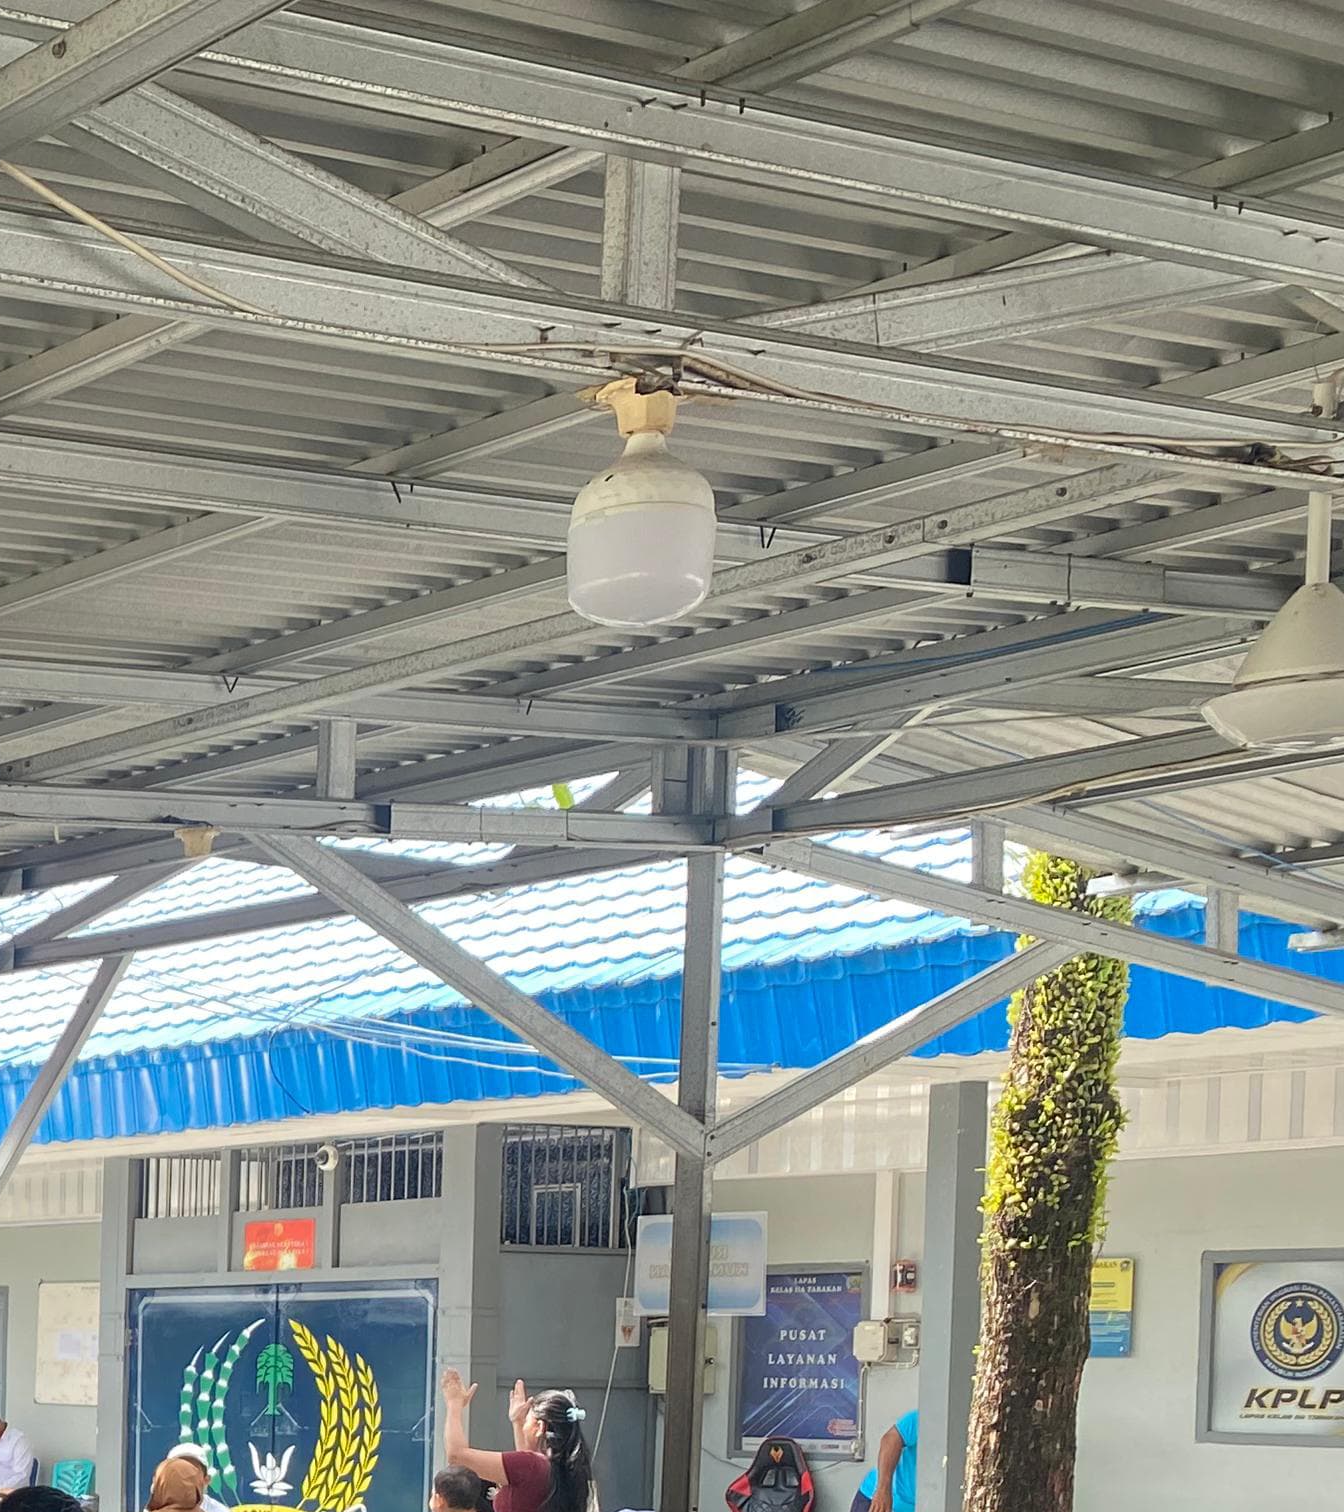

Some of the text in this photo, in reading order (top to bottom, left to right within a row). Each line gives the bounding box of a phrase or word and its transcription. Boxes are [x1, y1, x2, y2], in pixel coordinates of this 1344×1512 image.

[779, 1329, 827, 1341] PUSAT
[768, 1353, 837, 1366] LAYANAN
[762, 1376, 845, 1390] INFORMASI
[1244, 1388, 1344, 1409] KPLP
